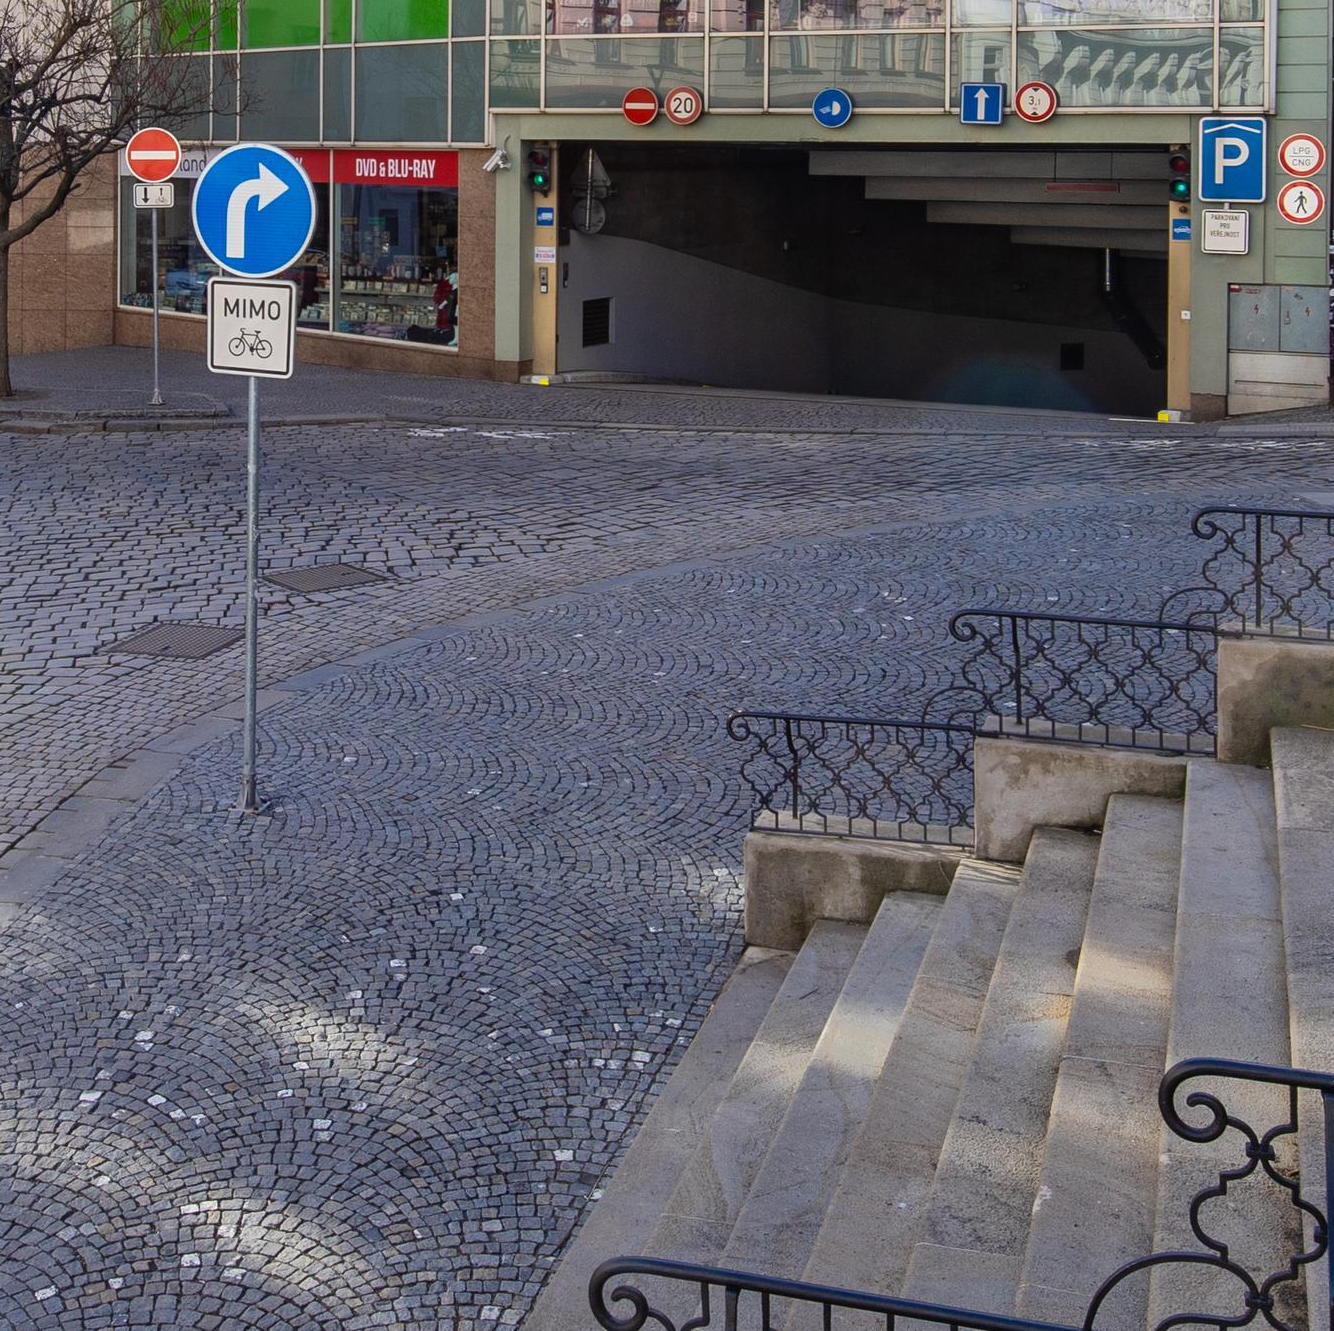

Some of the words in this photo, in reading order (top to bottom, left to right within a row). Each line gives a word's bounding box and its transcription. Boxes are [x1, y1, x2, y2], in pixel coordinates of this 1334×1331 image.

[673, 97, 694, 114] 20
[1293, 146, 1311, 155] LPG
[355, 158, 377, 177] DVD
[379, 162, 386, 178] &
[388, 158, 436, 179] BLU-RAY
[1215, 137, 1250, 184] P
[1292, 158, 1311, 166] CNG
[223, 297, 281, 320] MIMO
